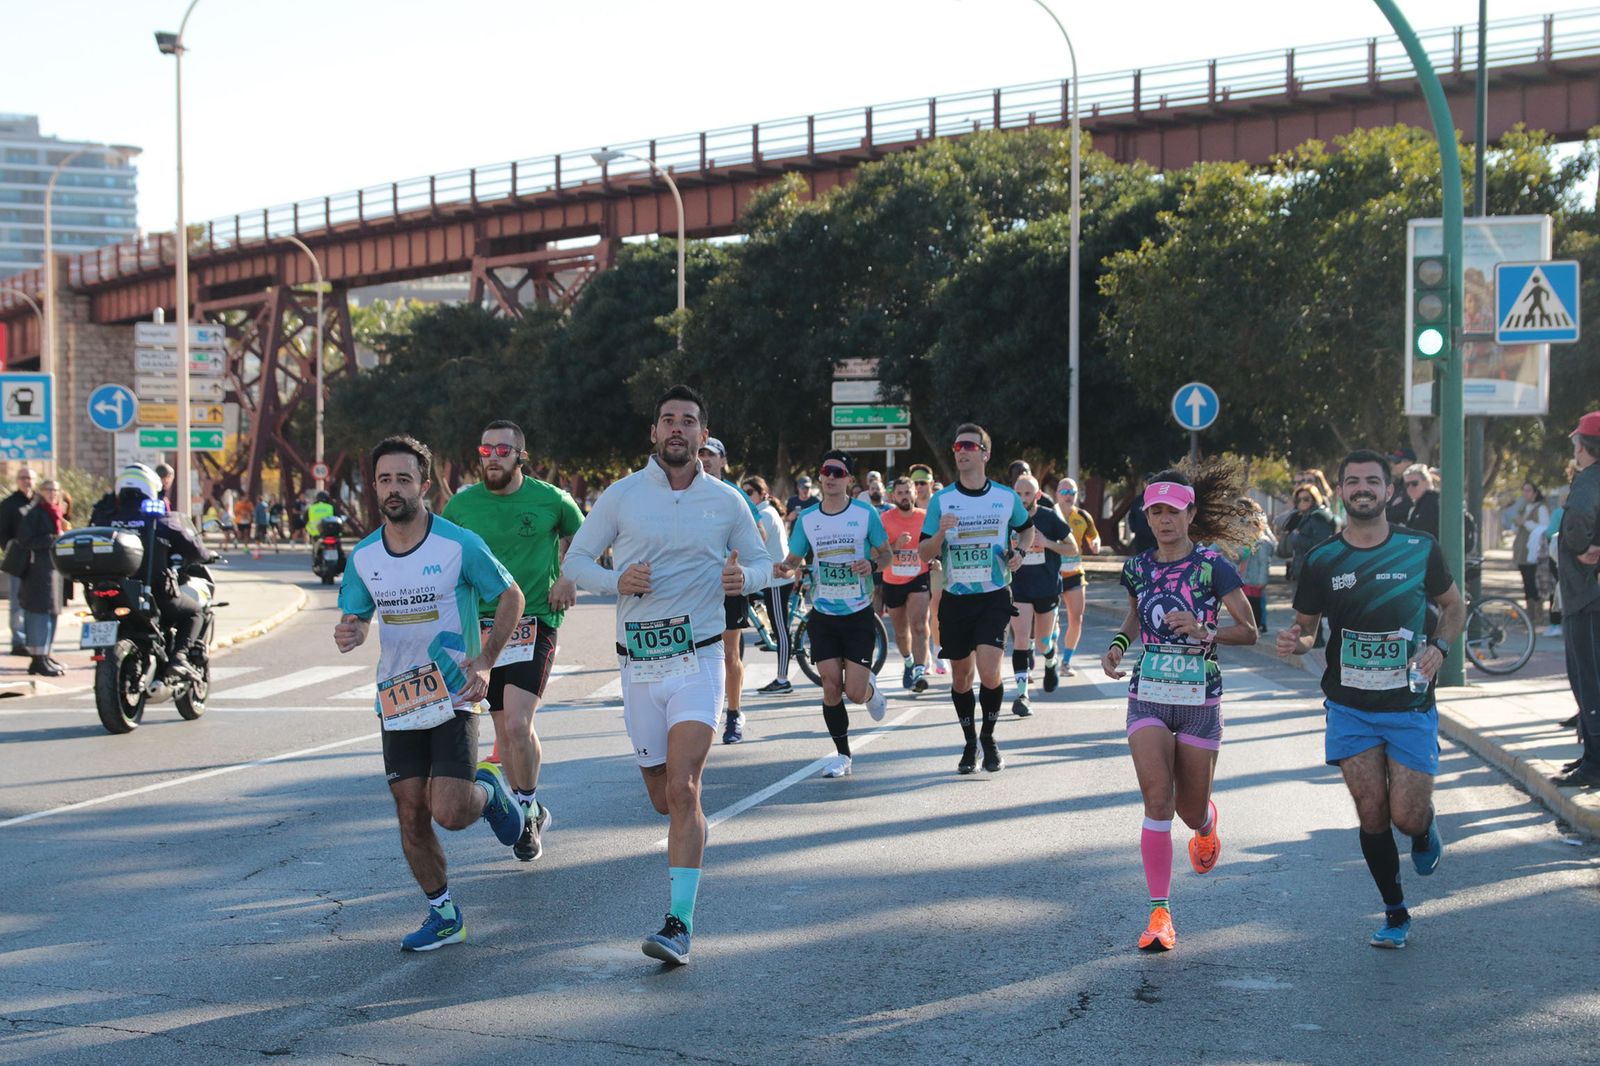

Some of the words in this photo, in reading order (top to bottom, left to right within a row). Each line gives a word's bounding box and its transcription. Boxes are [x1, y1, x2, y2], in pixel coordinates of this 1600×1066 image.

[955, 549, 988, 561] 1168
[823, 567, 853, 579] 1431
[375, 589, 397, 597] Medio
[399, 585, 436, 596] Maratón
[377, 595, 409, 607] Almería
[409, 592, 436, 605] 2022
[90, 624, 113, 634] 8437
[633, 626, 686, 649] 1050
[1348, 641, 1400, 659] 1549
[1150, 653, 1199, 673] 1204
[388, 674, 438, 706] 1170
